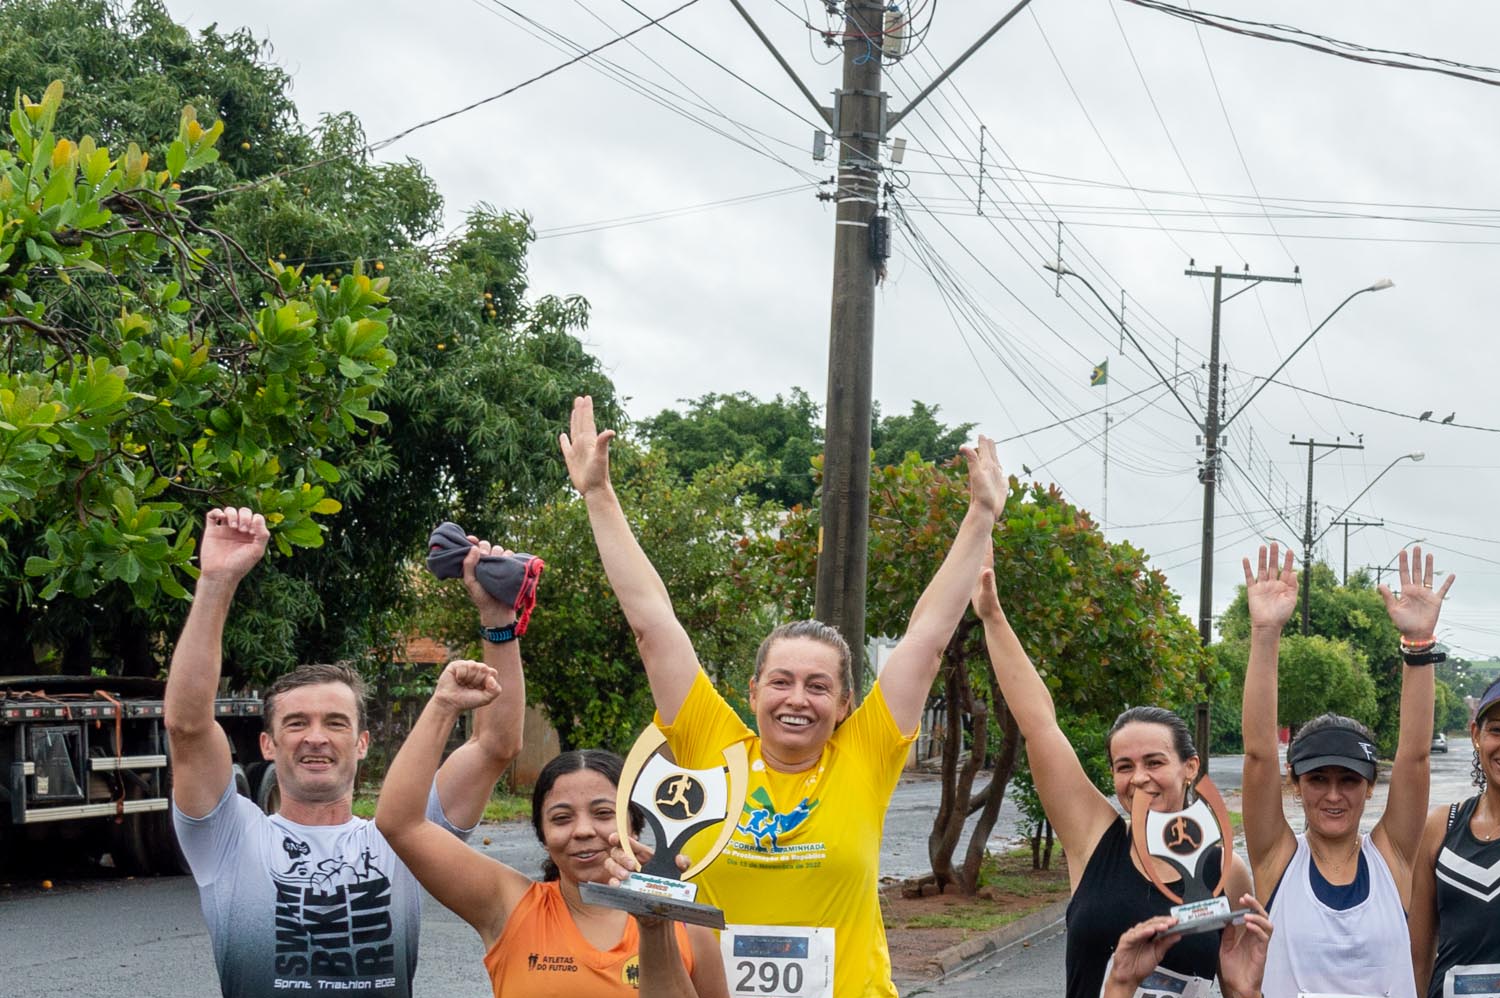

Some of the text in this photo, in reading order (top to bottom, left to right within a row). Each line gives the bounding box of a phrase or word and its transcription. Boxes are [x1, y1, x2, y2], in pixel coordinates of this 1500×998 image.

[348, 877, 394, 977] RUN
[317, 980, 372, 989] Triathlon
[375, 977, 396, 988] 2022
[736, 961, 804, 994] 290
